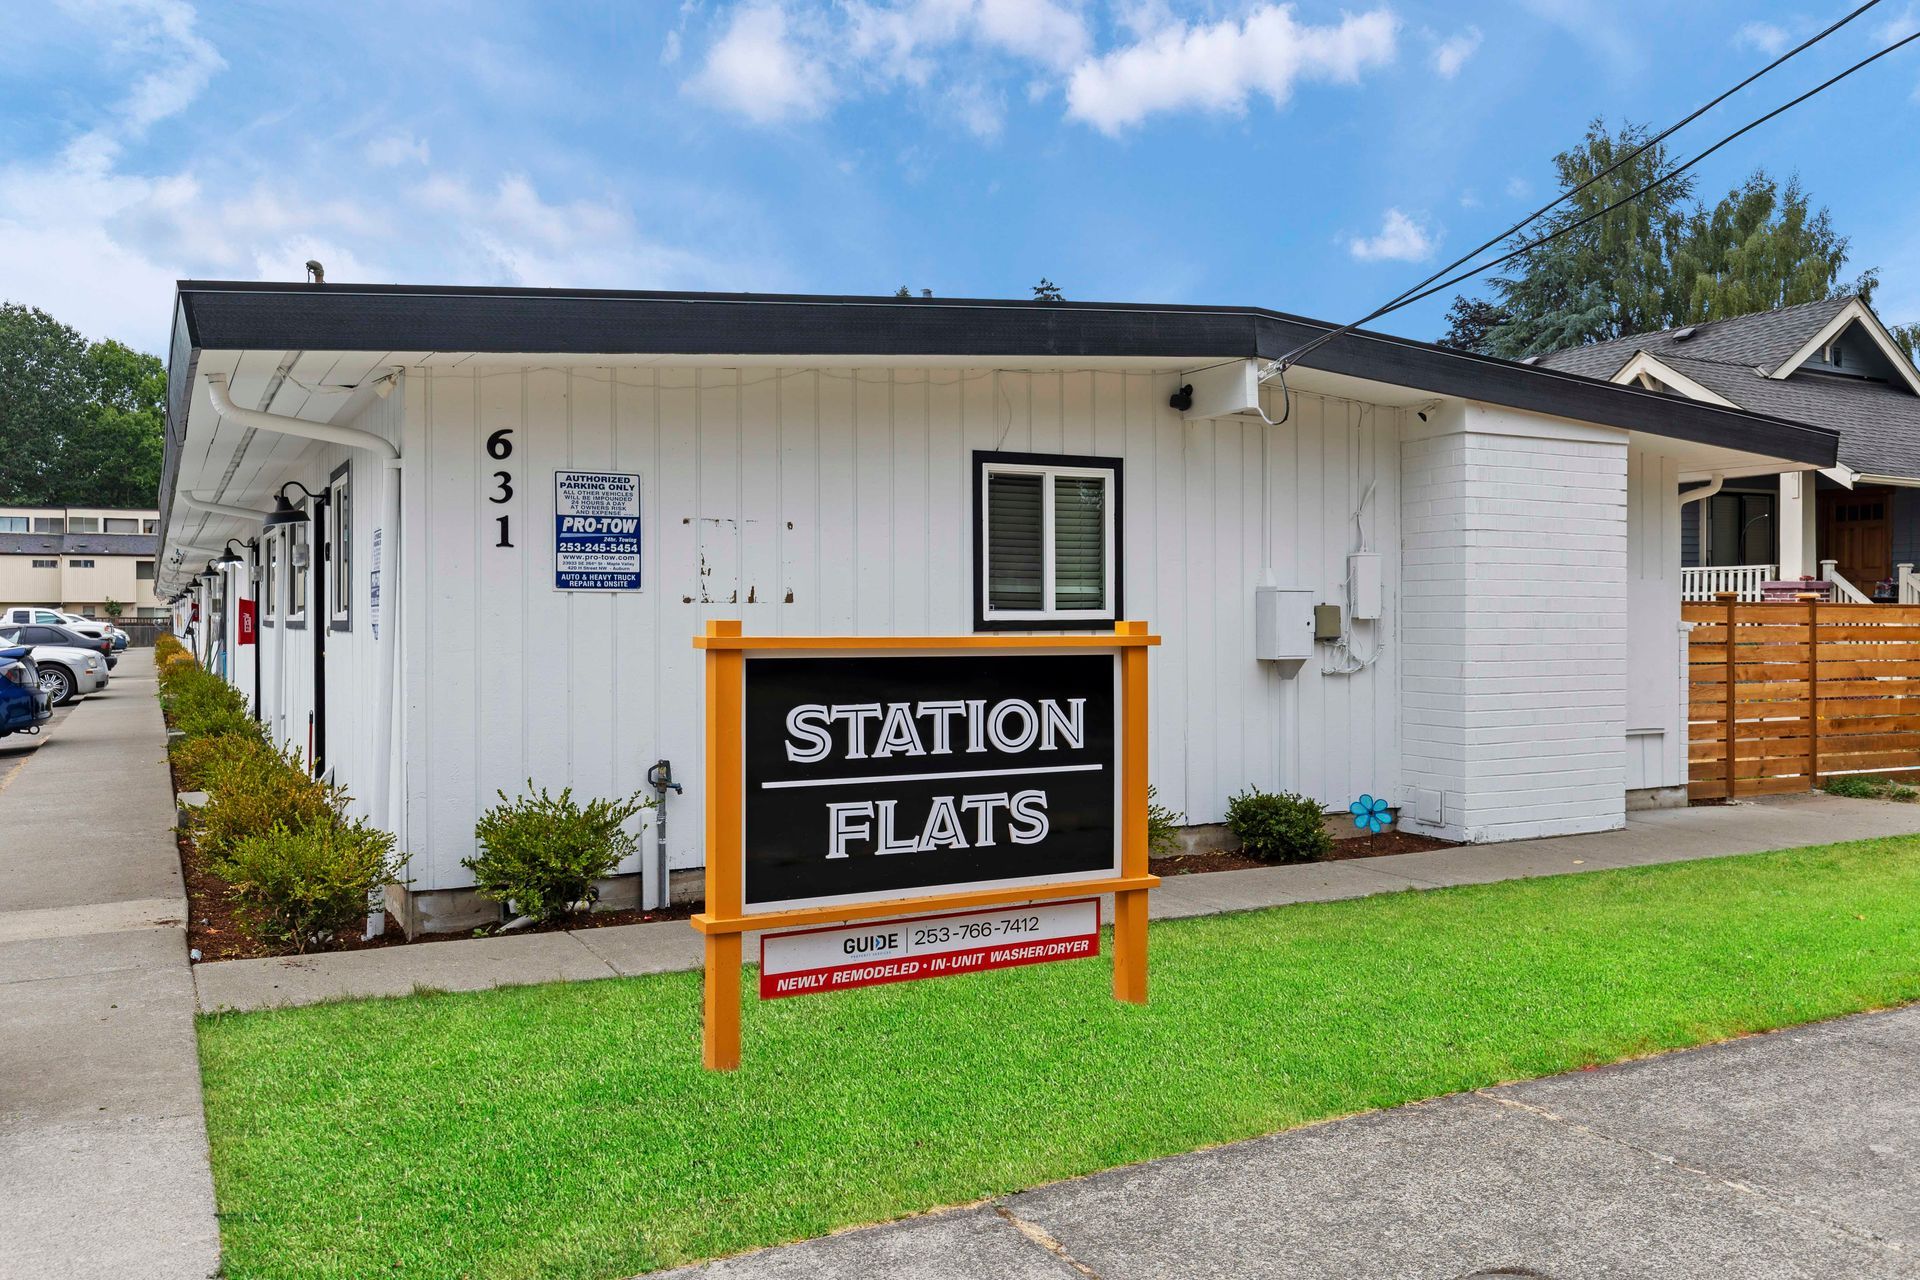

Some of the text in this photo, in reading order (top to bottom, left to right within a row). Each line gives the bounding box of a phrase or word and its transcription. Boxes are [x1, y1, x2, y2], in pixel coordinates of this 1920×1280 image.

[560, 482, 605, 490] PARKING
[566, 475, 630, 483] AUTHORIZED
[562, 517, 637, 533] PRO-TOW
[784, 698, 1087, 764] STATION
[825, 789, 1050, 860] FLATS
[843, 916, 1040, 954] GUIDE 253-766-7412
[776, 940, 1090, 992] NEWLY REMODELED IN-UNIT WASHER/DRYER
